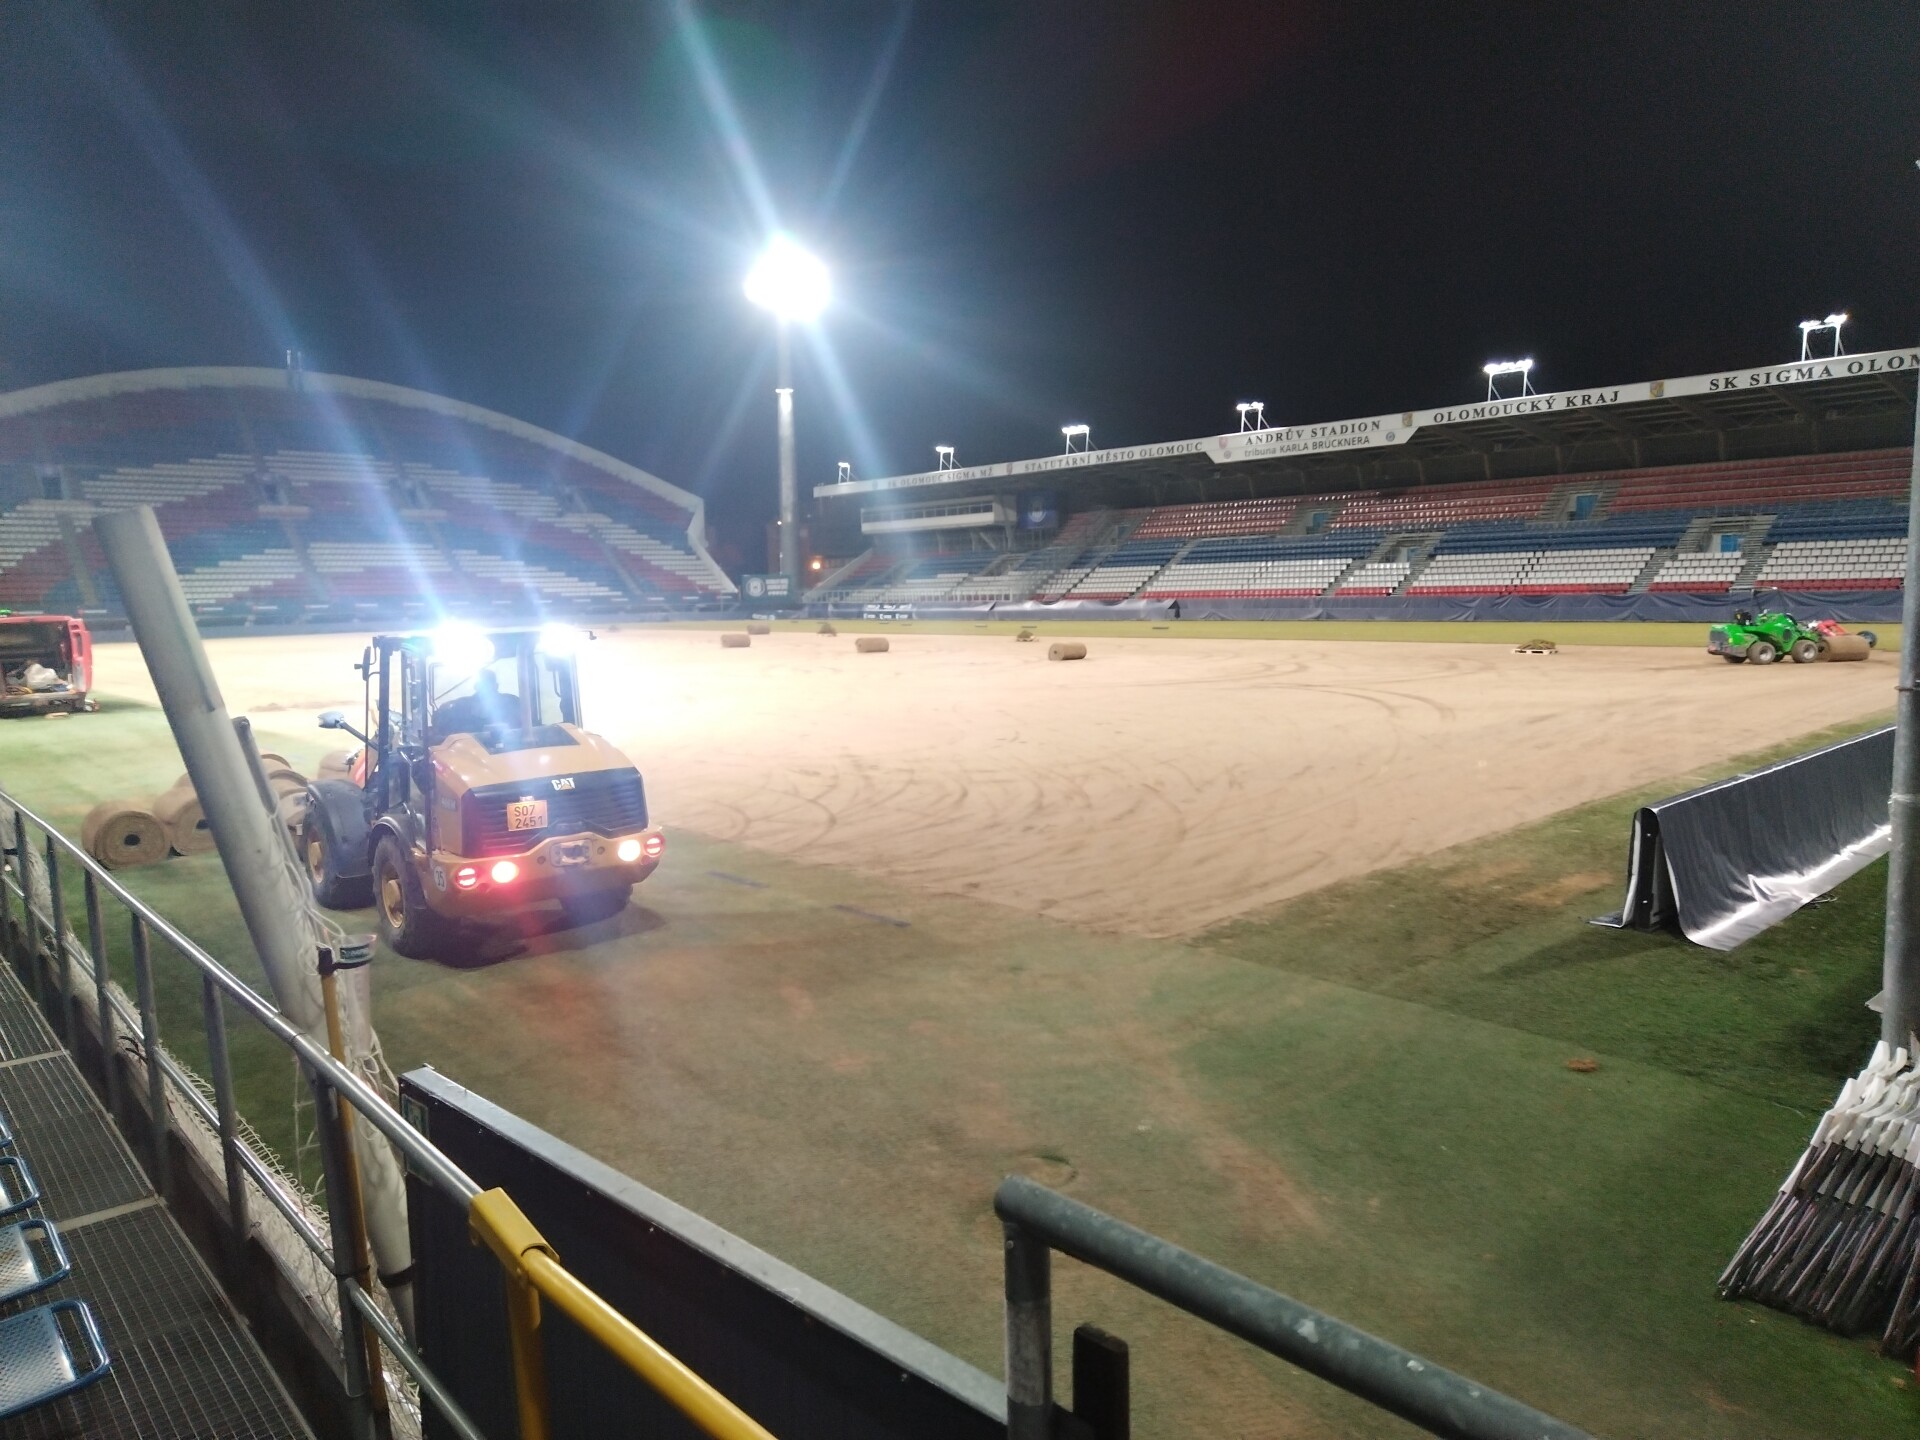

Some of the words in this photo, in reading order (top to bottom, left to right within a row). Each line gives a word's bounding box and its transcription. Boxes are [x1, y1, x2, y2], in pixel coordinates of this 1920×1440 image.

[1709, 376, 1738, 391] SK
[1750, 364, 1834, 387] SIGMA
[1433, 395, 1557, 424] OLOMOUCKÝ
[1565, 390, 1620, 408] KRAJ
[1246, 428, 1305, 446] ANDRŮV
[1310, 420, 1382, 438] STADION
[1024, 454, 1091, 472] STATUTÁRNÍ
[1096, 449, 1135, 463] MĚSTO
[1139, 442, 1203, 457] OLOMOUC
[1244, 446, 1277, 457] tribuna
[1279, 442, 1309, 454] KARLA
[1311, 435, 1370, 451] BRÜCKNERA
[900, 474, 944, 487] OLOMOUC
[947, 471, 976, 481] SIGMA
[551, 777, 576, 791] CAT
[515, 815, 543, 830] 2451
